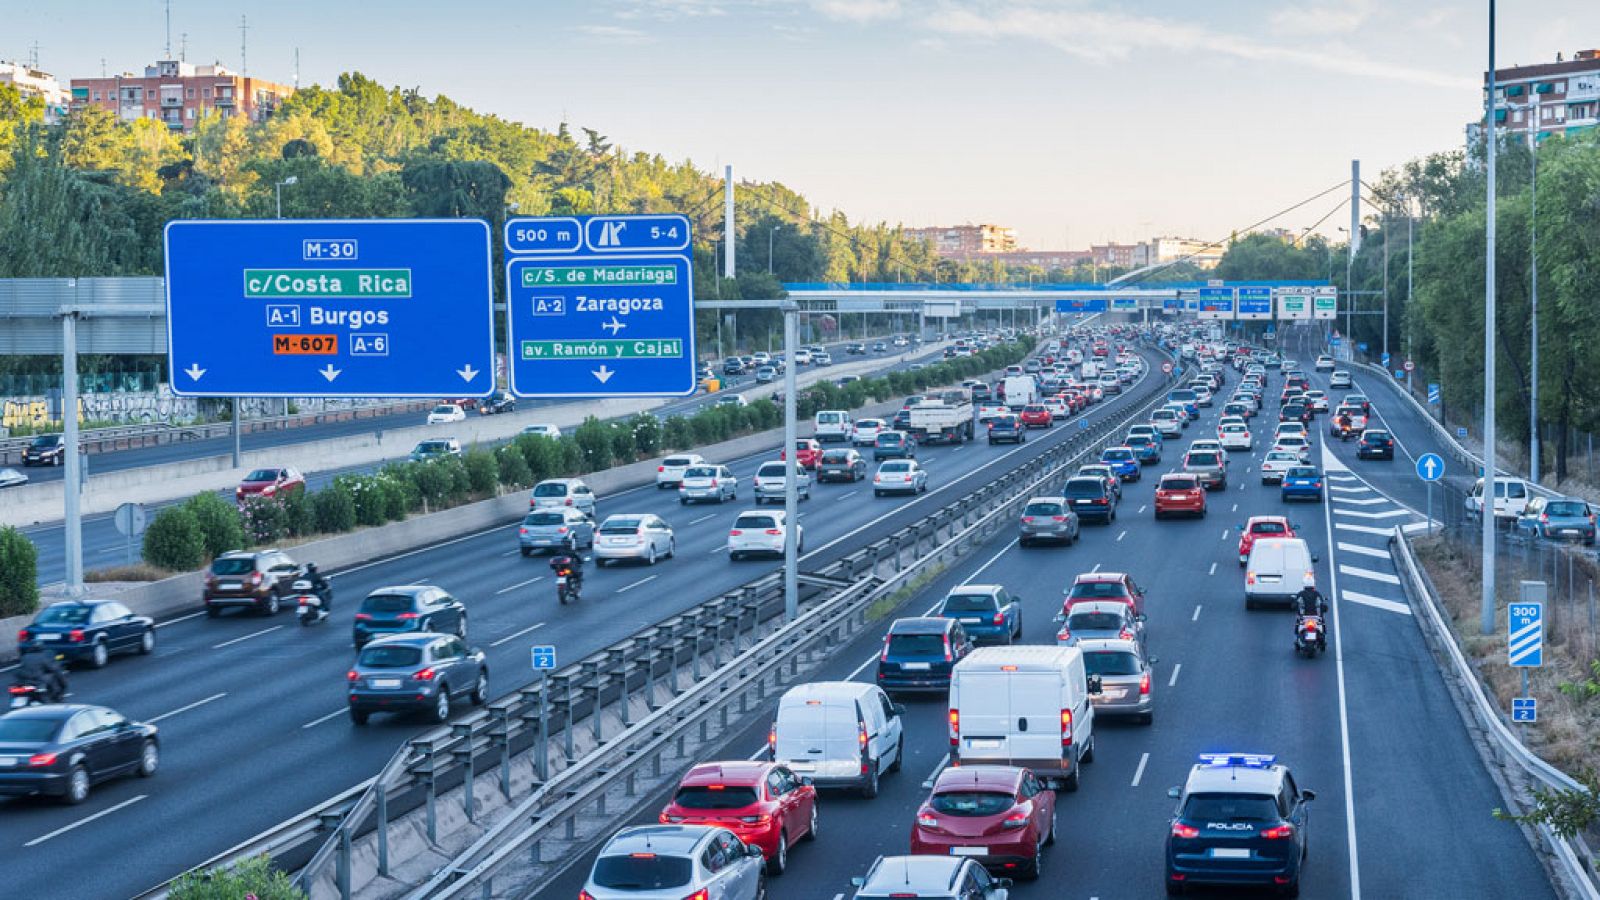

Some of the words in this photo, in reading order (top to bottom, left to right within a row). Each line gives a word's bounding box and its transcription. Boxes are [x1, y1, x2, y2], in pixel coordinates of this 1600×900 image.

[516, 229, 547, 242] 500
[557, 231, 570, 241] m
[650, 226, 678, 240] 5-4
[307, 243, 354, 257] M-30
[524, 270, 561, 283] c/S.
[566, 270, 586, 282] de
[593, 268, 674, 284] Madariaga
[249, 274, 342, 293] c/Costa
[358, 274, 408, 293] Rica
[536, 299, 562, 312] A-2
[575, 296, 664, 315] Zaragoza
[270, 308, 298, 323] A-1
[310, 306, 389, 329] Burgos
[275, 337, 335, 351] M-607
[354, 337, 385, 352] A-6
[524, 344, 547, 356] av.
[553, 341, 607, 356] Ramón
[615, 344, 624, 358] y
[633, 341, 679, 357] Cajal
[1513, 607, 1537, 617] 300
[539, 656, 548, 667] 2
[1520, 711, 1529, 720] 2
